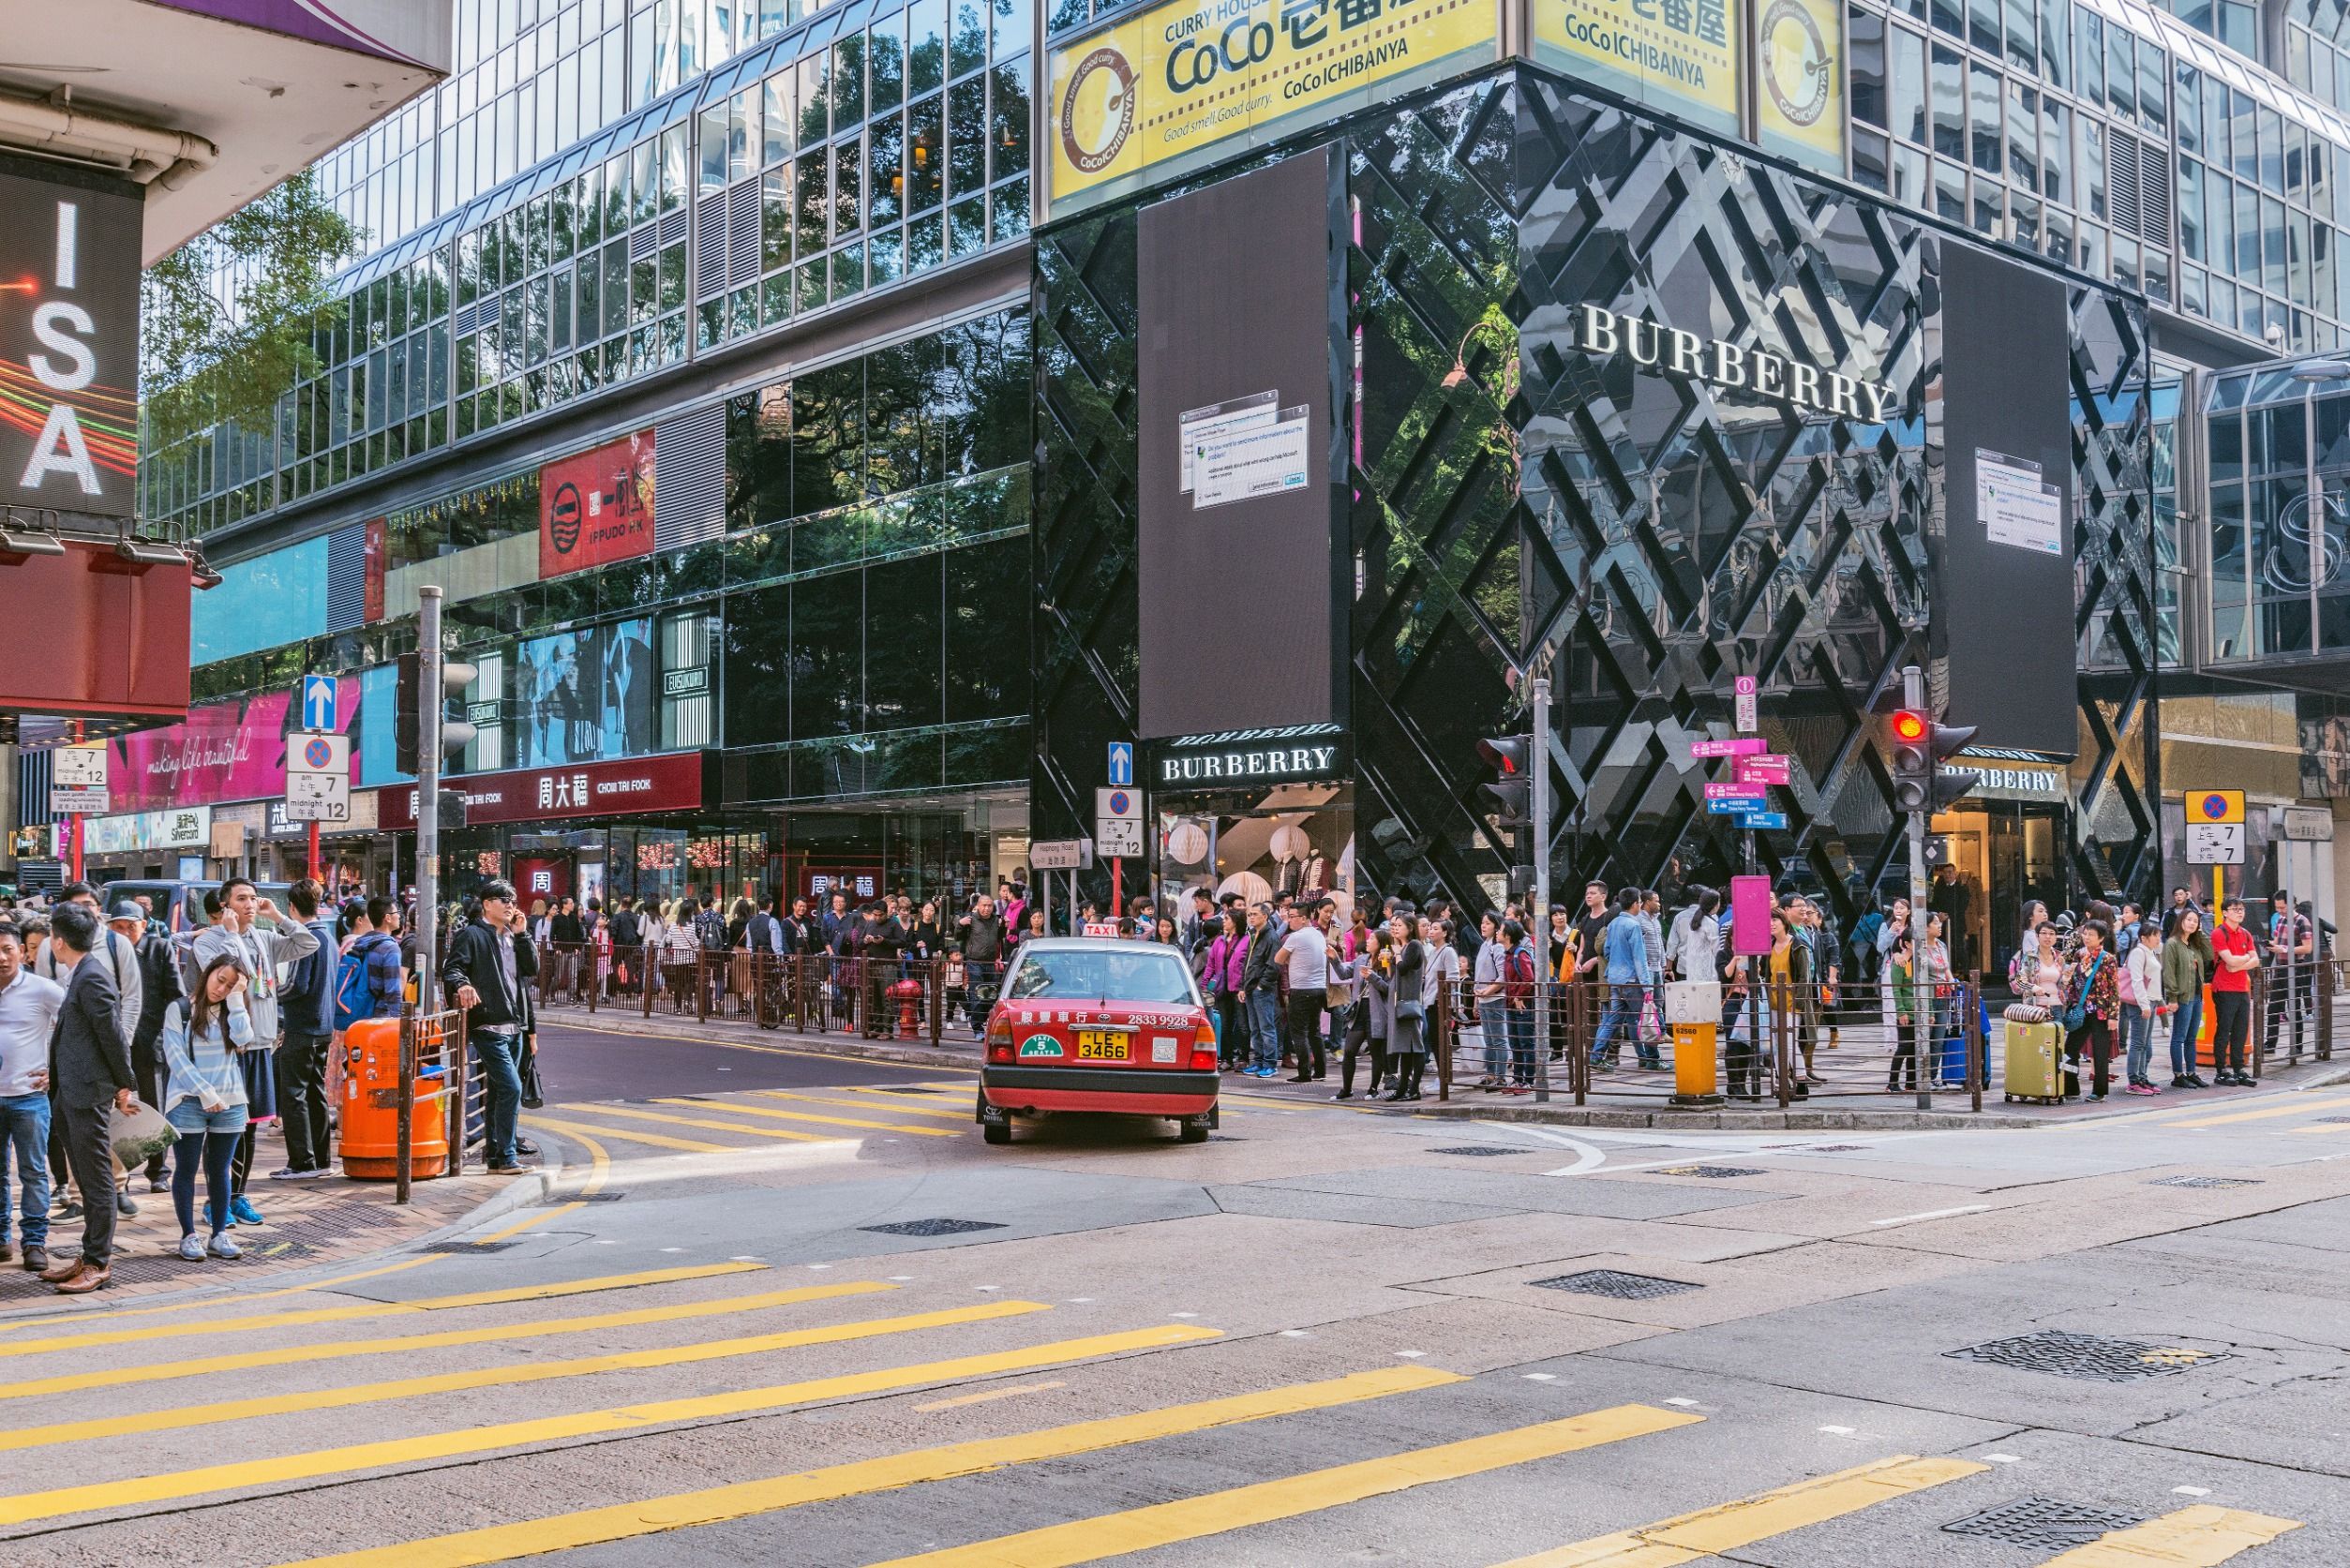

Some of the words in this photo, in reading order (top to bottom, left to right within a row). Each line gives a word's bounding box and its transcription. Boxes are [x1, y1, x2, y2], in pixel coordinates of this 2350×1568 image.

[1165, 7, 1212, 43] CURRY
[1166, 15, 1275, 94] CoCo
[1565, 13, 1610, 52] CoCo
[1613, 31, 1706, 90] ICHIBANYA
[1283, 74, 1321, 99] CoCo
[1324, 37, 1409, 85] ICHIBANYA
[1163, 124, 1190, 142] Good
[1580, 302, 1898, 425] BURBERRY
[590, 524, 626, 545] IPPUDO
[87, 752, 96, 763] 7
[147, 742, 181, 789] making
[203, 727, 250, 780] beautiful
[1162, 747, 1335, 781] BURBERRY
[87, 770, 103, 783] 12
[298, 783, 316, 792] 上午
[326, 777, 337, 792] 7
[597, 782, 618, 794] CHOW
[619, 781, 631, 793] TAI
[631, 779, 651, 791] FOOK
[486, 793, 501, 803] FOOK
[538, 774, 590, 810] 周大福
[291, 799, 322, 808] midnight
[327, 802, 345, 818] 12
[298, 809, 316, 817] 午夜
[1126, 822, 1133, 833] 7
[2224, 827, 2234, 840] 7
[172, 828, 199, 842] Silvercord
[2197, 832, 2215, 841] 上午
[1126, 842, 1140, 854] 12
[2224, 847, 2235, 861] 7
[532, 872, 551, 892] 周
[811, 875, 874, 897] 周福
[1086, 926, 1115, 935] TAXI
[1128, 1014, 1157, 1024] 2833
[1160, 1015, 1189, 1025] 9928
[1037, 1041, 1046, 1051] 5
[1094, 1033, 1114, 1045] LE
[1082, 1044, 1125, 1058] 3466
